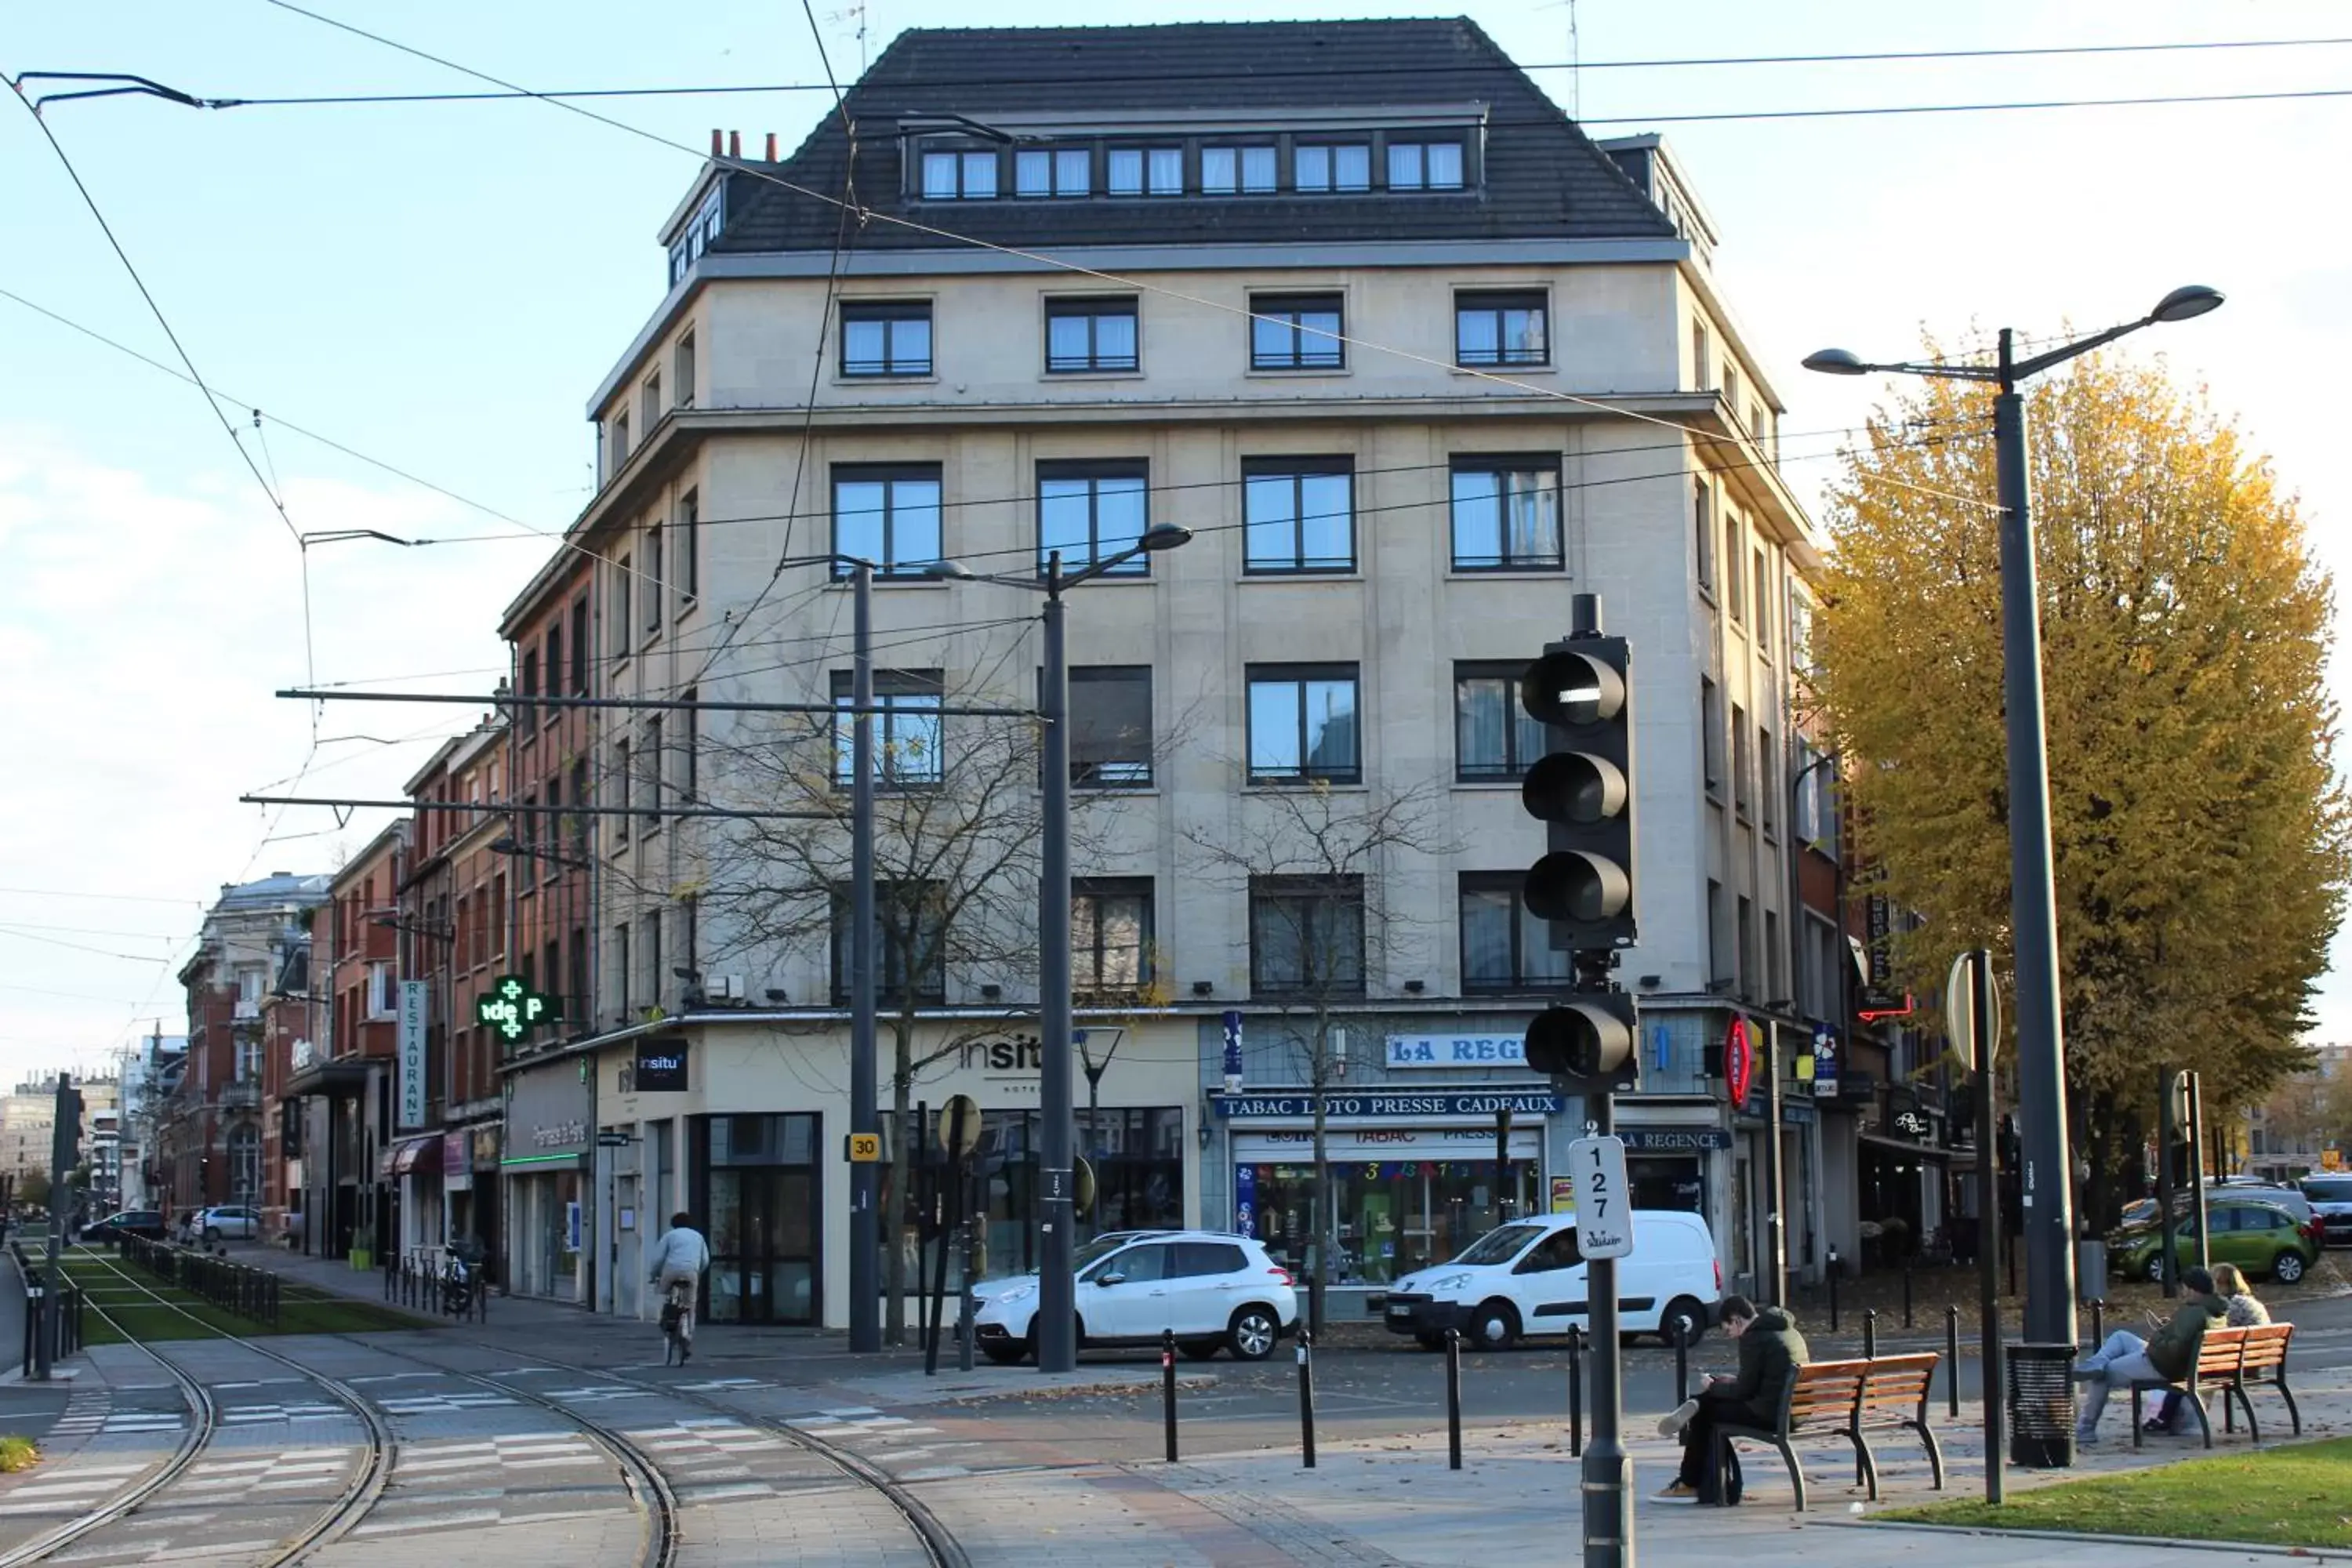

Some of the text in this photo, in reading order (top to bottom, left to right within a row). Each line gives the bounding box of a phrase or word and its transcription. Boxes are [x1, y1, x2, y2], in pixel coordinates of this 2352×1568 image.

[407, 982, 419, 1124] RESTAURANT
[960, 1033, 1042, 1069] insit
[1394, 1039, 1526, 1061] LA REG
[640, 1057, 677, 1069] insitu
[1224, 1097, 1556, 1114] TABAC LTO PRESSE CADEAUX
[855, 1140, 875, 1155] 30
[1645, 1134, 1719, 1149] REGENCE
